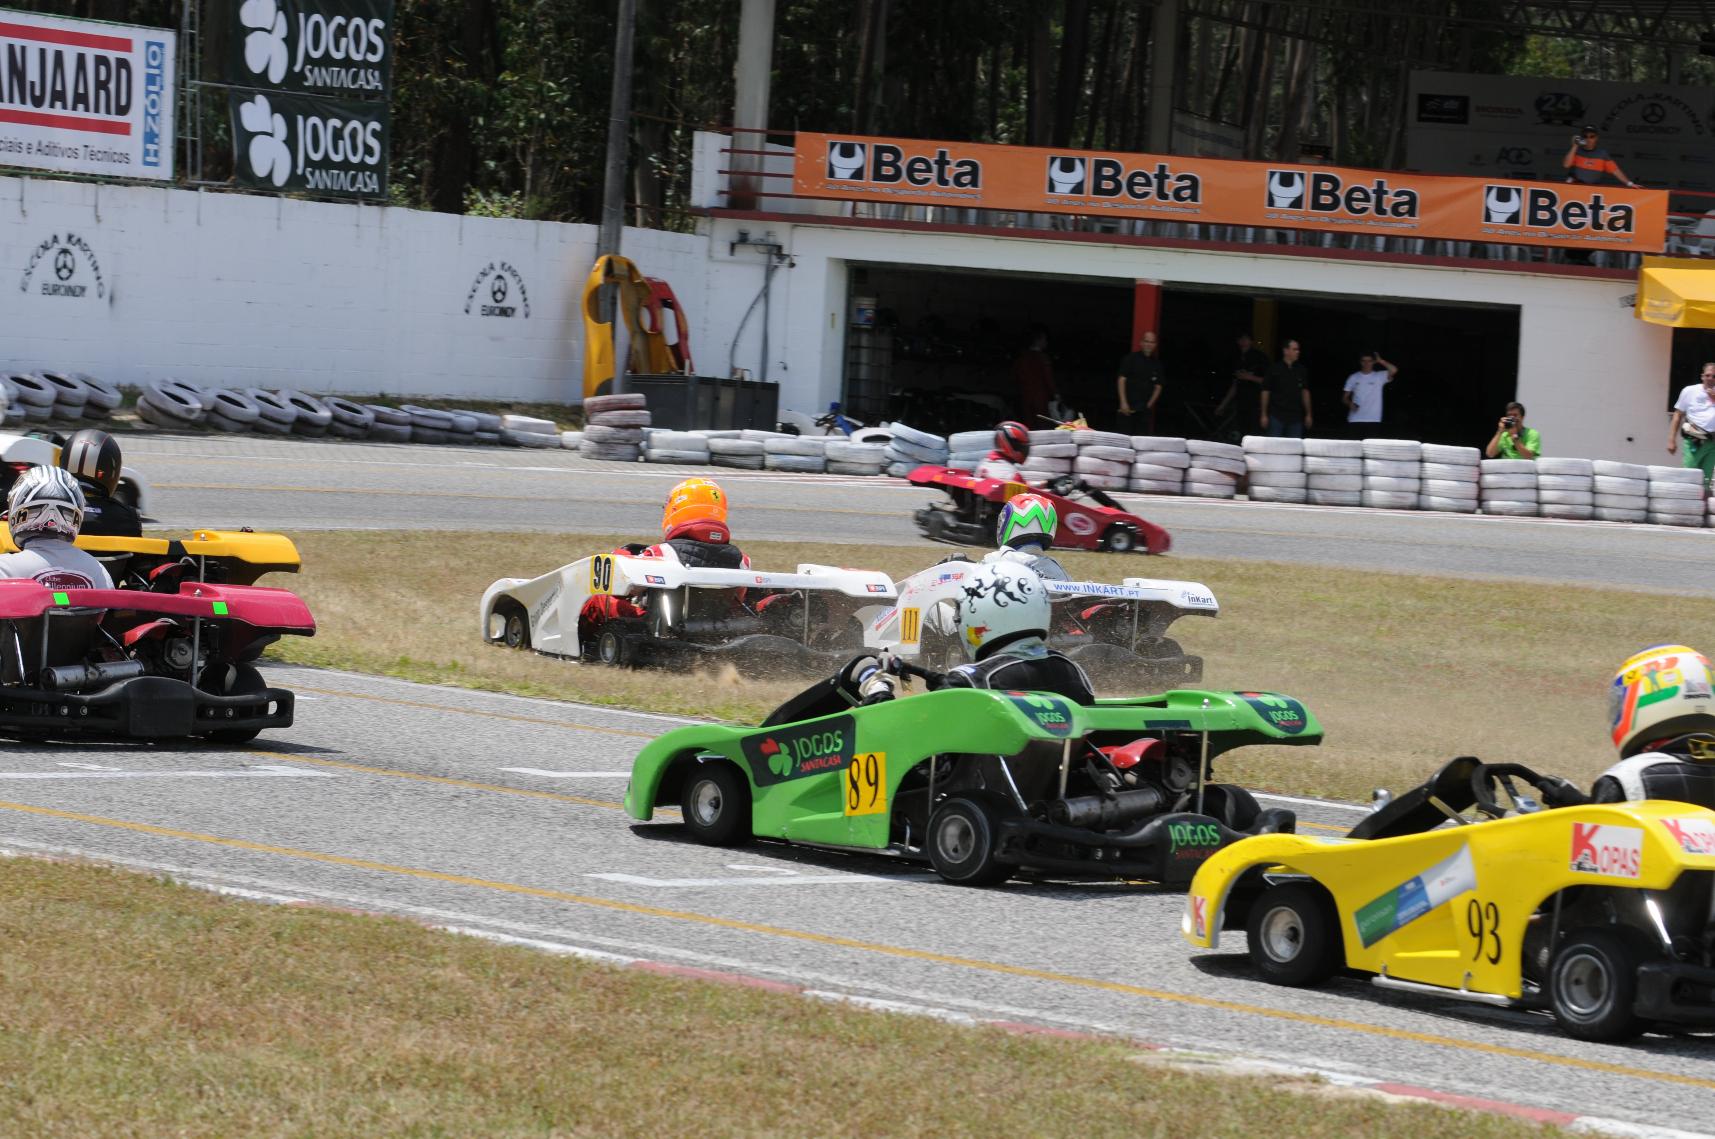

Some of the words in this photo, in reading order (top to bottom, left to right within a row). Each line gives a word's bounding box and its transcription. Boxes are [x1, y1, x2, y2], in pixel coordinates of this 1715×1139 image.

[293, 13, 385, 73] JOGOS
[0, 43, 132, 117] NJAARD
[36, 140, 80, 160] Aditivos
[83, 144, 131, 165] Técnicos
[296, 114, 382, 175] JOGOS
[871, 142, 982, 190] Beta
[1091, 156, 1203, 205] Beta
[1308, 171, 1420, 220] Beta
[1525, 187, 1635, 234] Beta
[594, 555, 611, 591] 90
[792, 730, 844, 768] JOGOS
[849, 754, 879, 811] 89
[1168, 824, 1221, 853] JOGOS
[1468, 899, 1502, 965] 93
